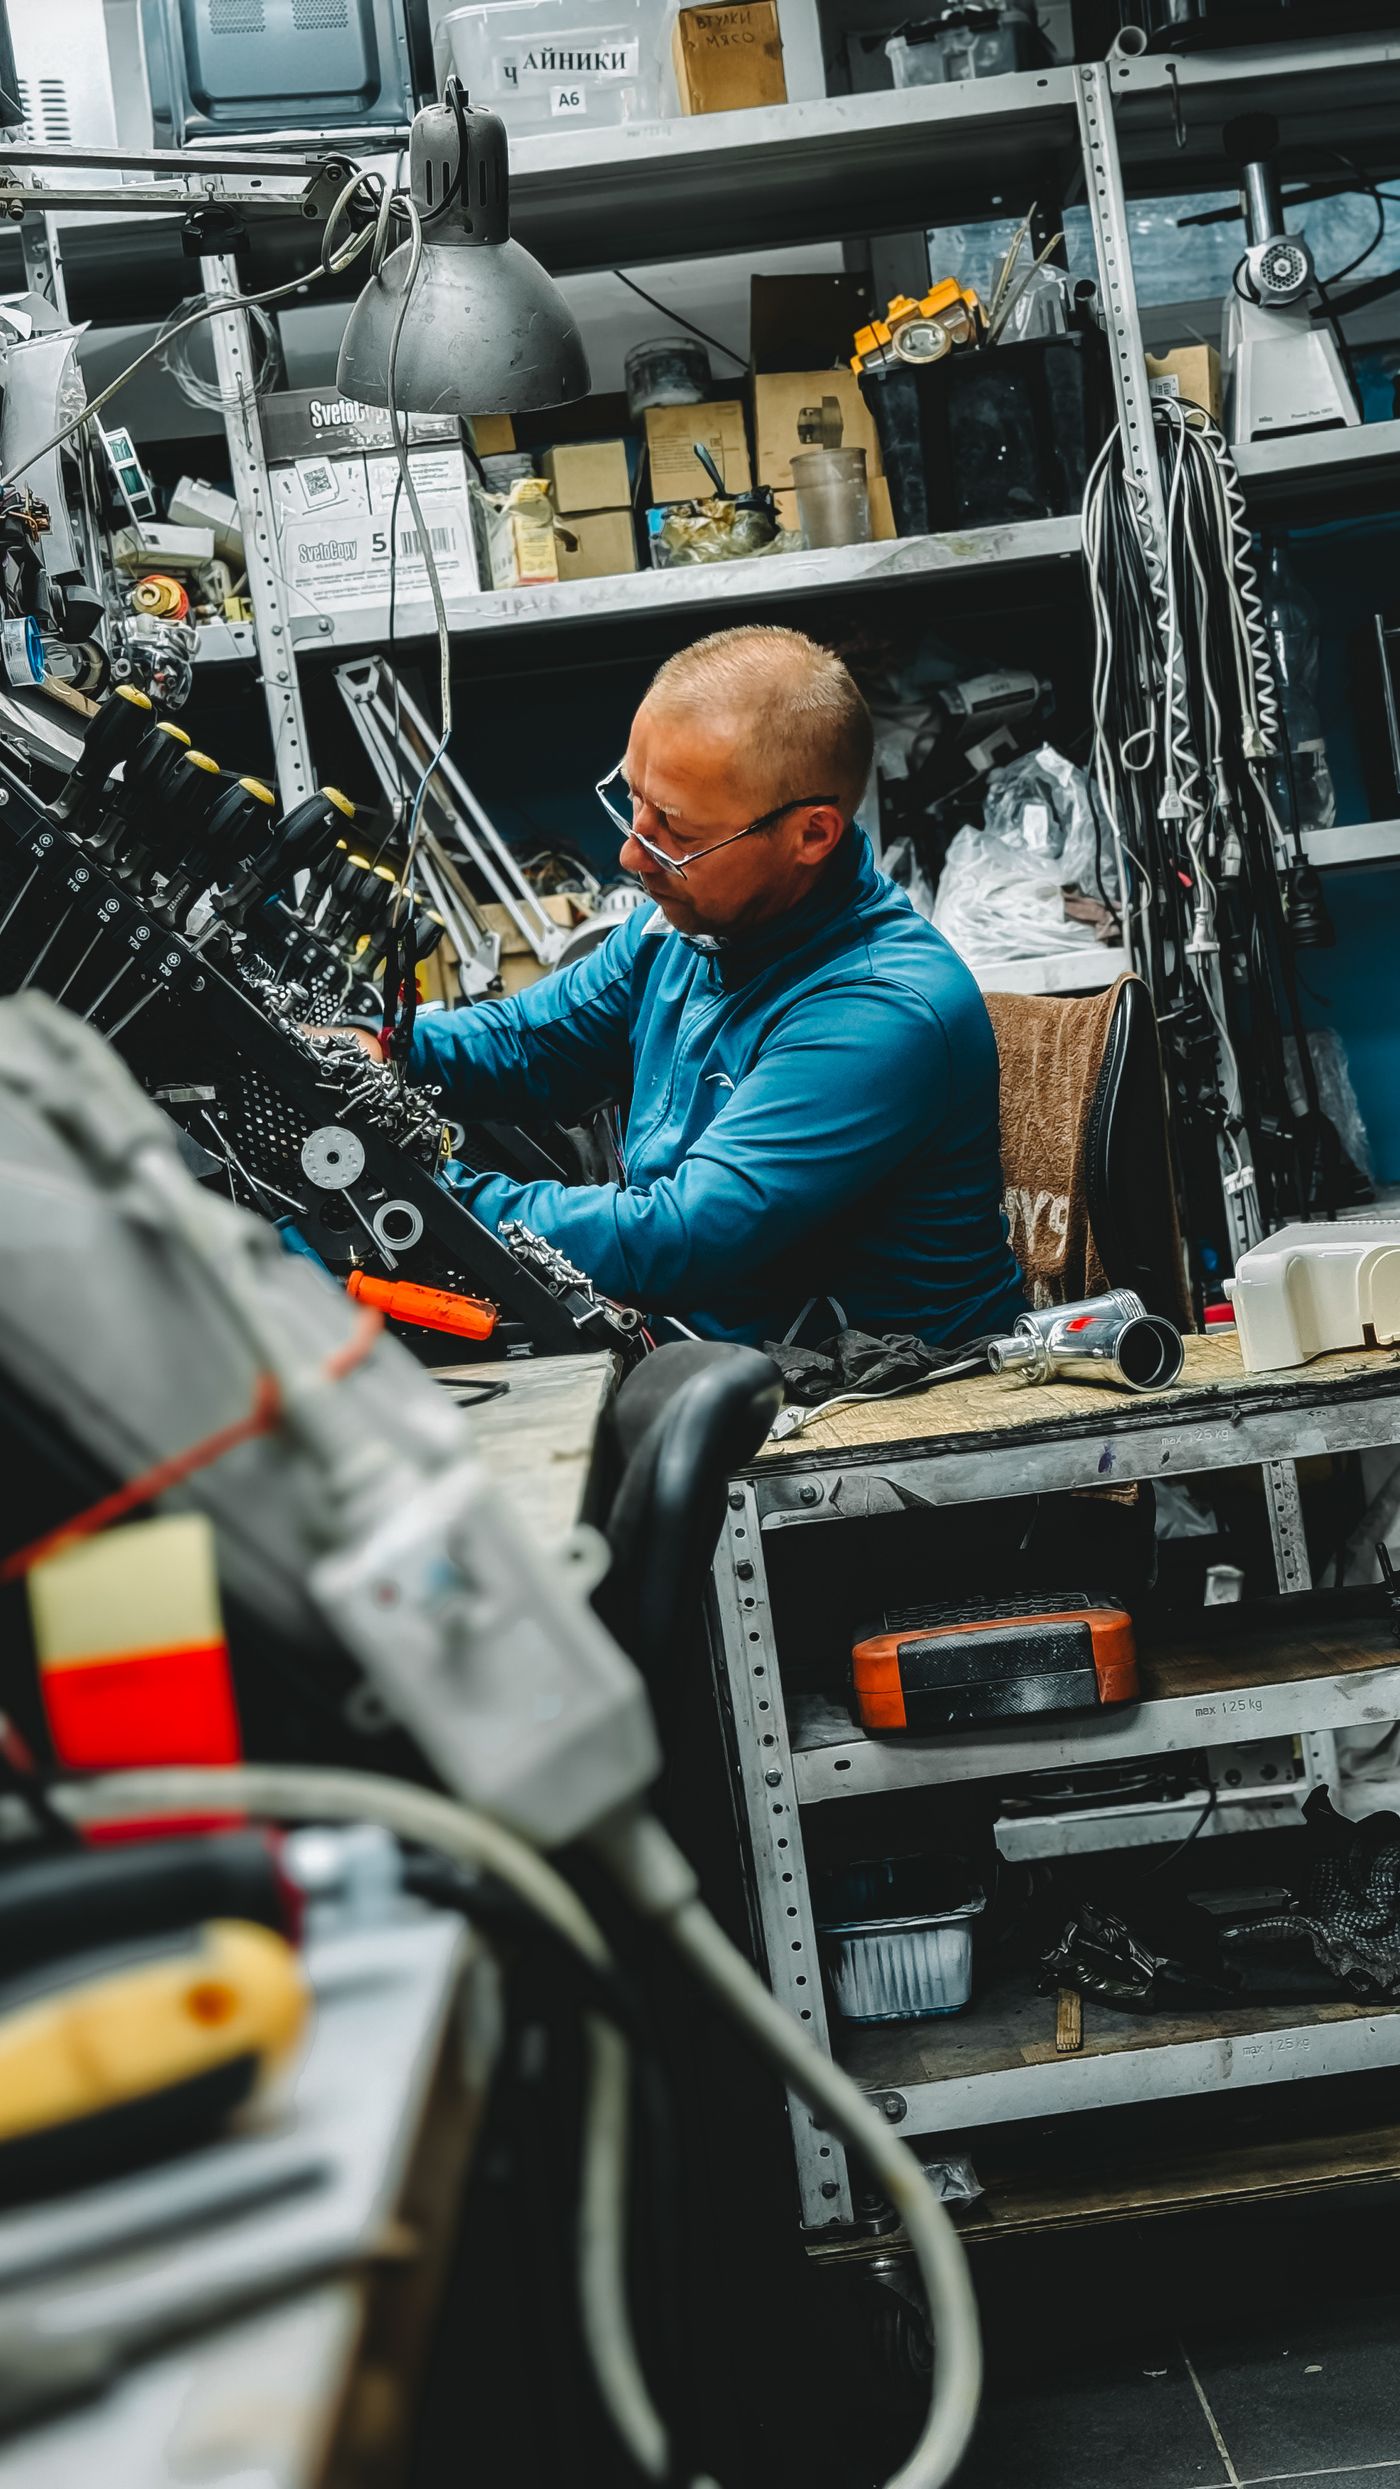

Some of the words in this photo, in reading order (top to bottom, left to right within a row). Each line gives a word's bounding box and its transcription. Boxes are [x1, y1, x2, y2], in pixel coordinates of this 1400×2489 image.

[706, 32, 754, 48] МЯСО
[298, 540, 358, 563] SvetoCopy
[372, 532, 387, 552] 5
[31, 843, 44, 857] T10
[67, 877, 81, 892] T15
[97, 908, 110, 922] T20
[128, 935, 141, 950] T25
[159, 962, 172, 977] T30
[1195, 1706, 1216, 1717] max
[1222, 1700, 1246, 1713] 125
[1249, 1699, 1263, 1712] kg
[1242, 2045, 1264, 2056] max
